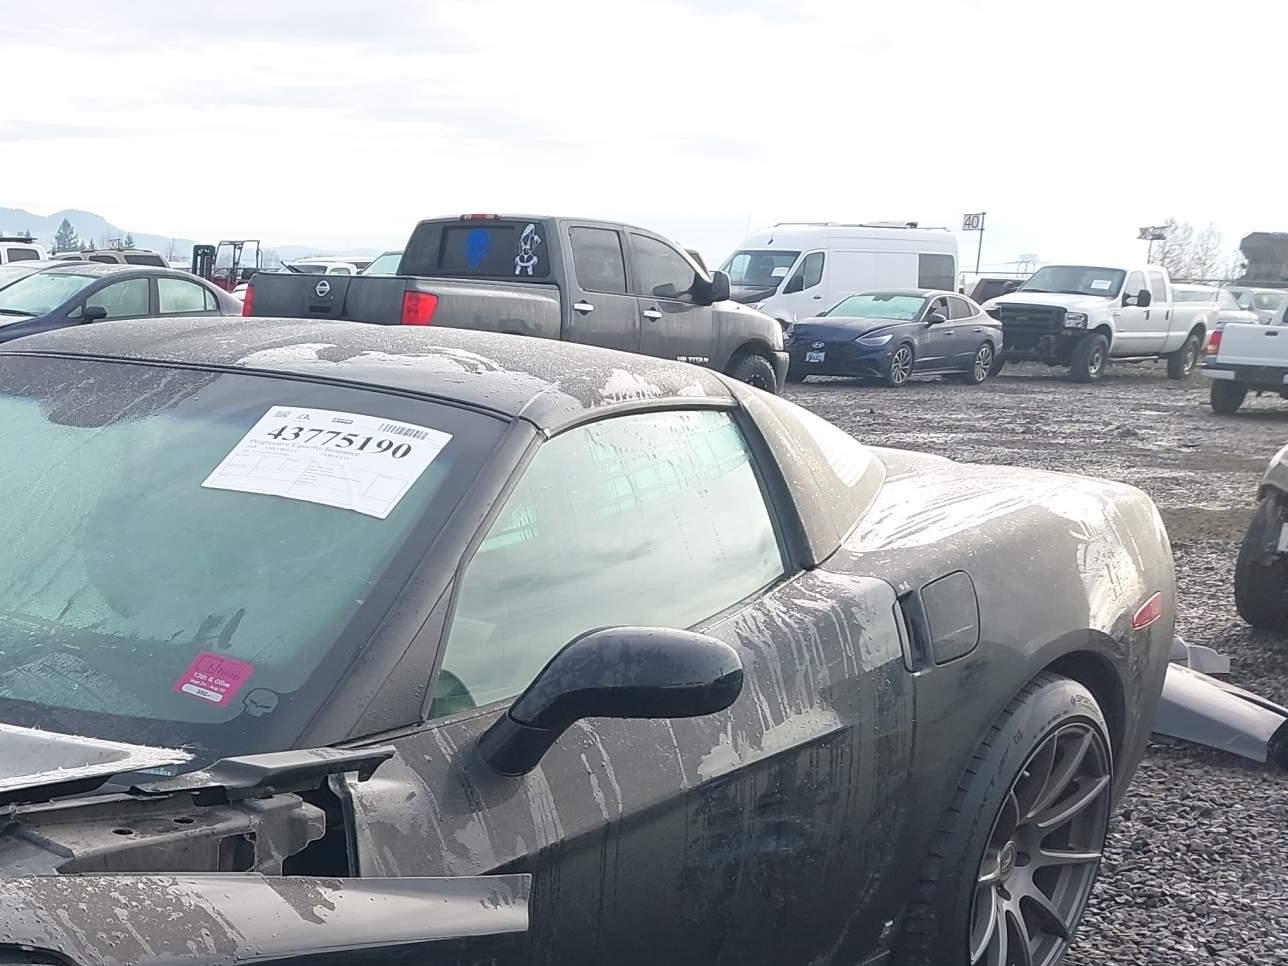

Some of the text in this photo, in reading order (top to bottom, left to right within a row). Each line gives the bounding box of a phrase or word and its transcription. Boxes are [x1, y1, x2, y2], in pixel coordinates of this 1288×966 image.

[963, 215, 980, 229] 40
[688, 355, 710, 364] TITAN
[267, 424, 413, 460] 43775190
